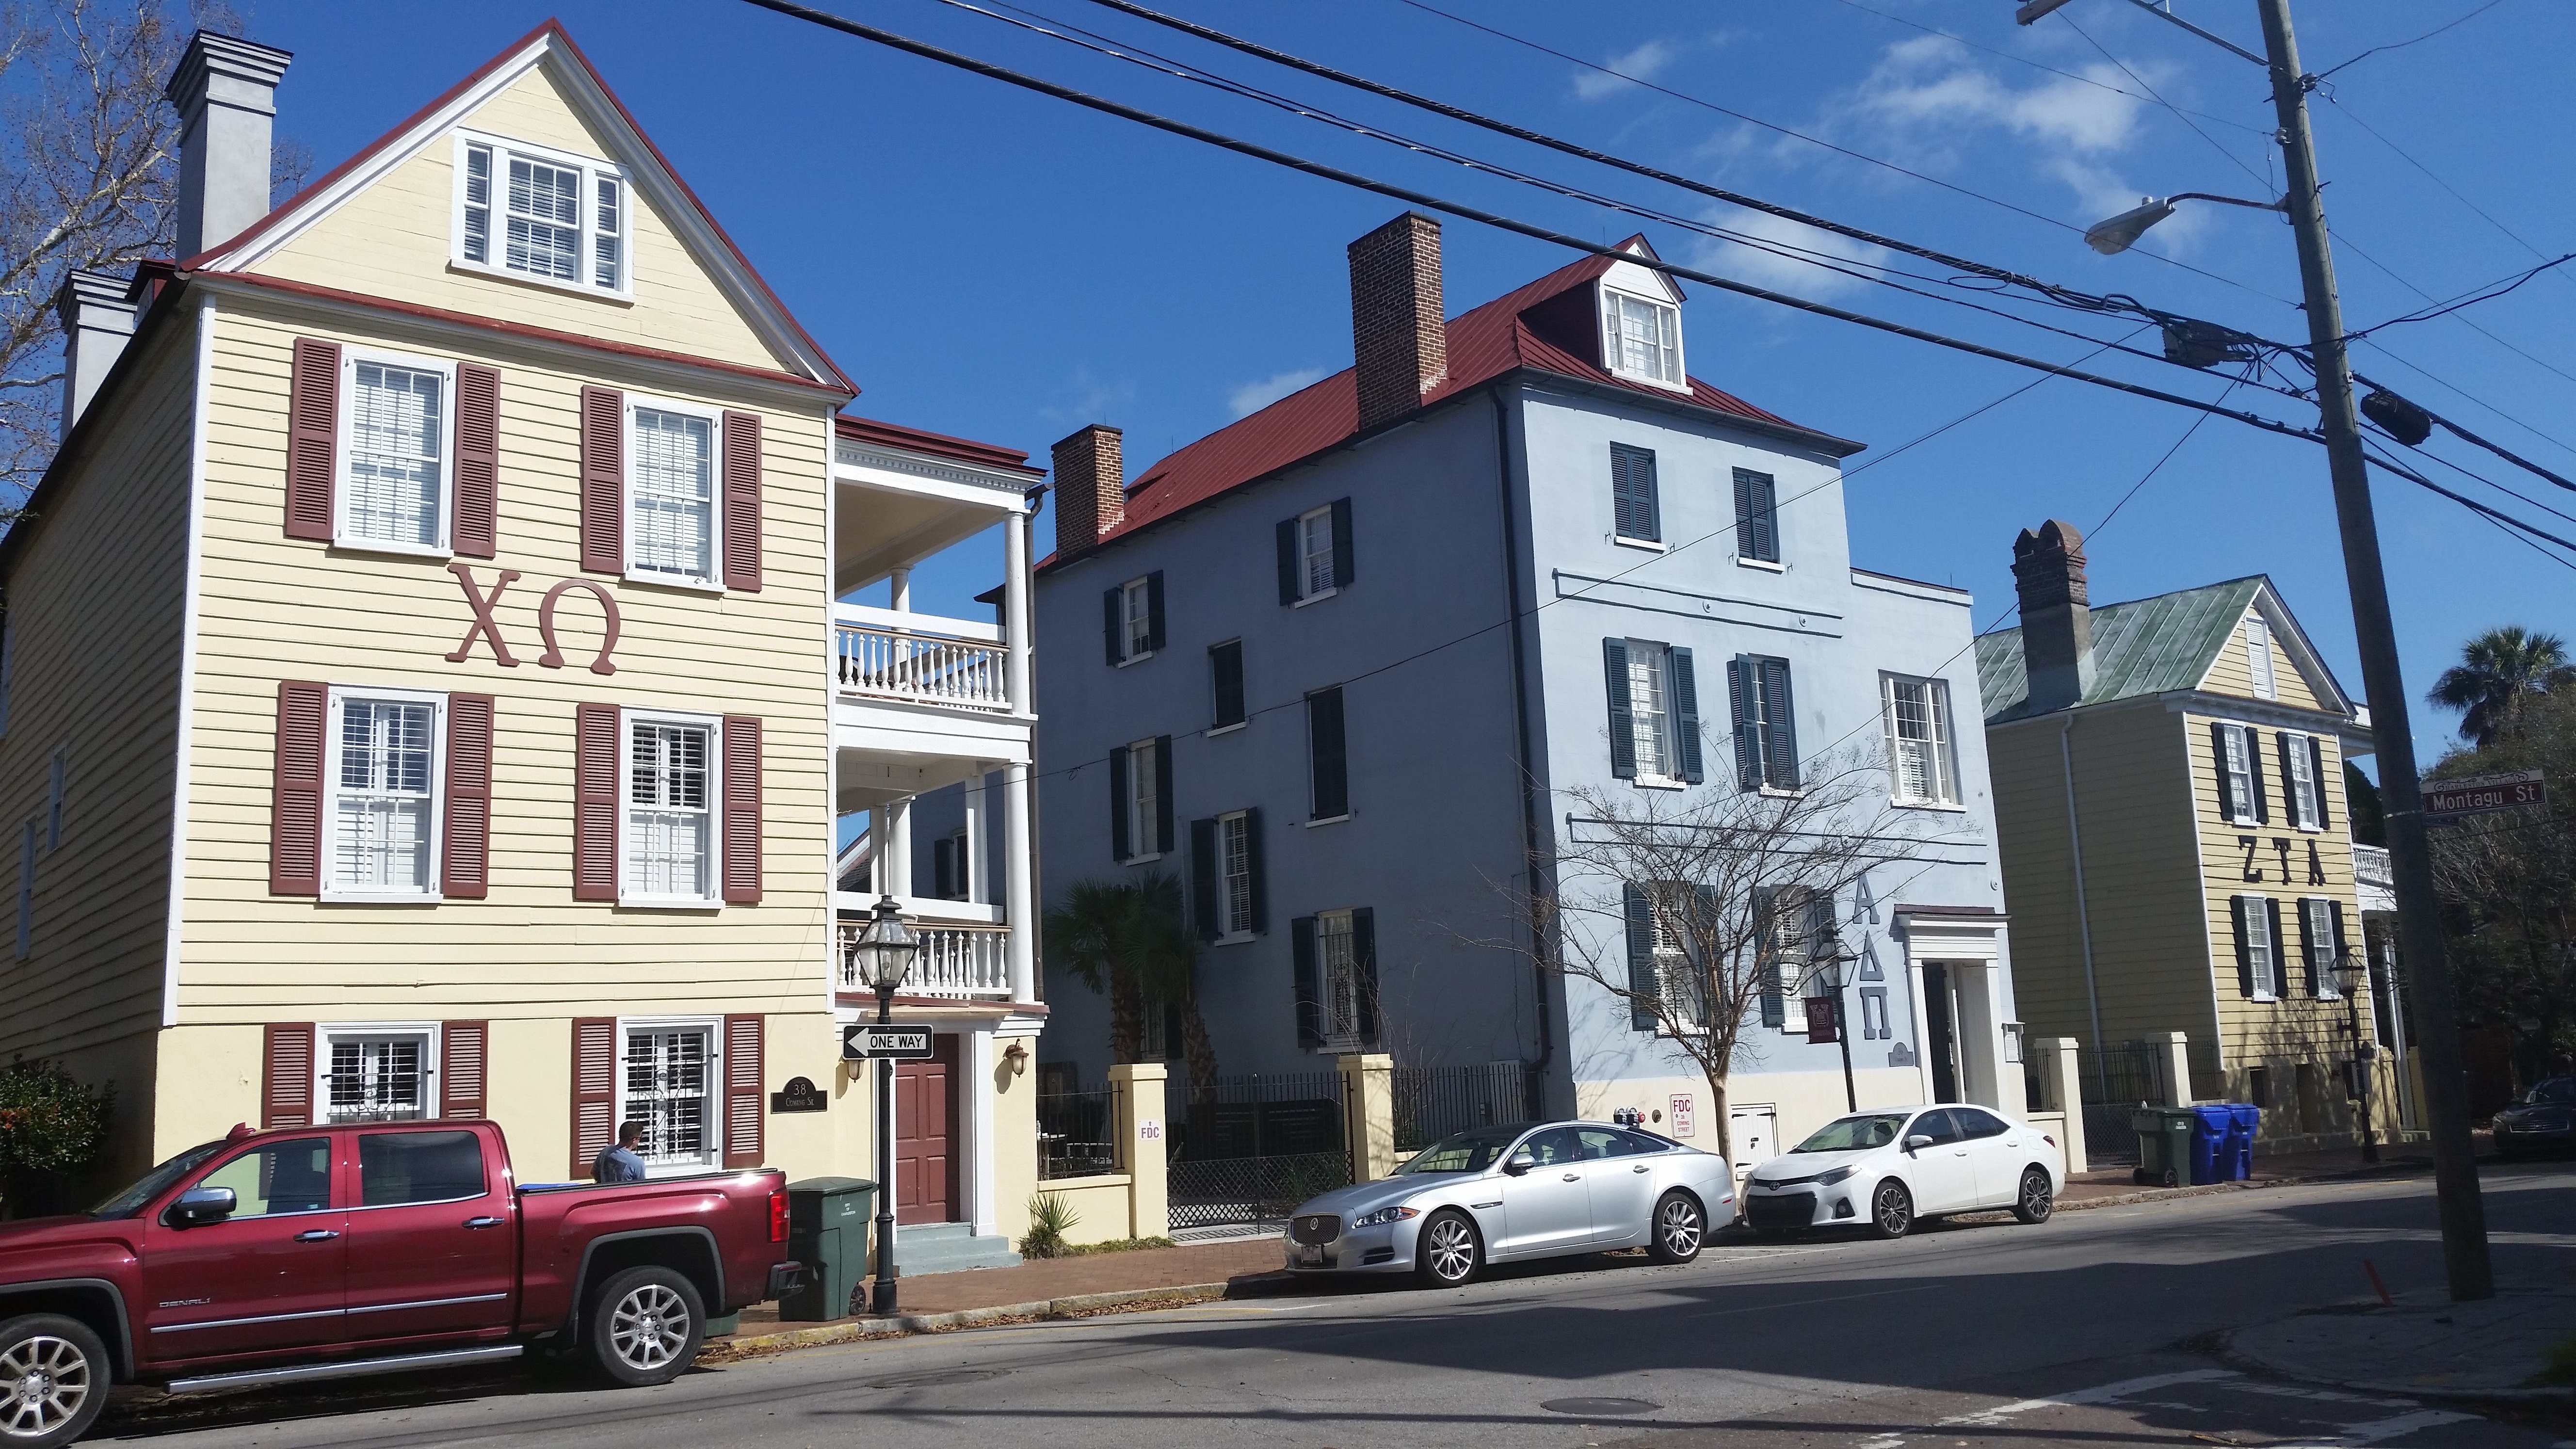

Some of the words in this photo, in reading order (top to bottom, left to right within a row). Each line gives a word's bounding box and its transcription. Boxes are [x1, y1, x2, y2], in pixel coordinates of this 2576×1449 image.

[2433, 790, 2503, 811] Montagu
[2516, 785, 2535, 802] St
[870, 1035, 894, 1048] ONE
[898, 1035, 923, 1048] WAY
[794, 1084, 806, 1095] 38
[1673, 1099, 1690, 1112] FDC
[1141, 1127, 1159, 1139] FDC
[159, 1298, 210, 1307] DENALI
